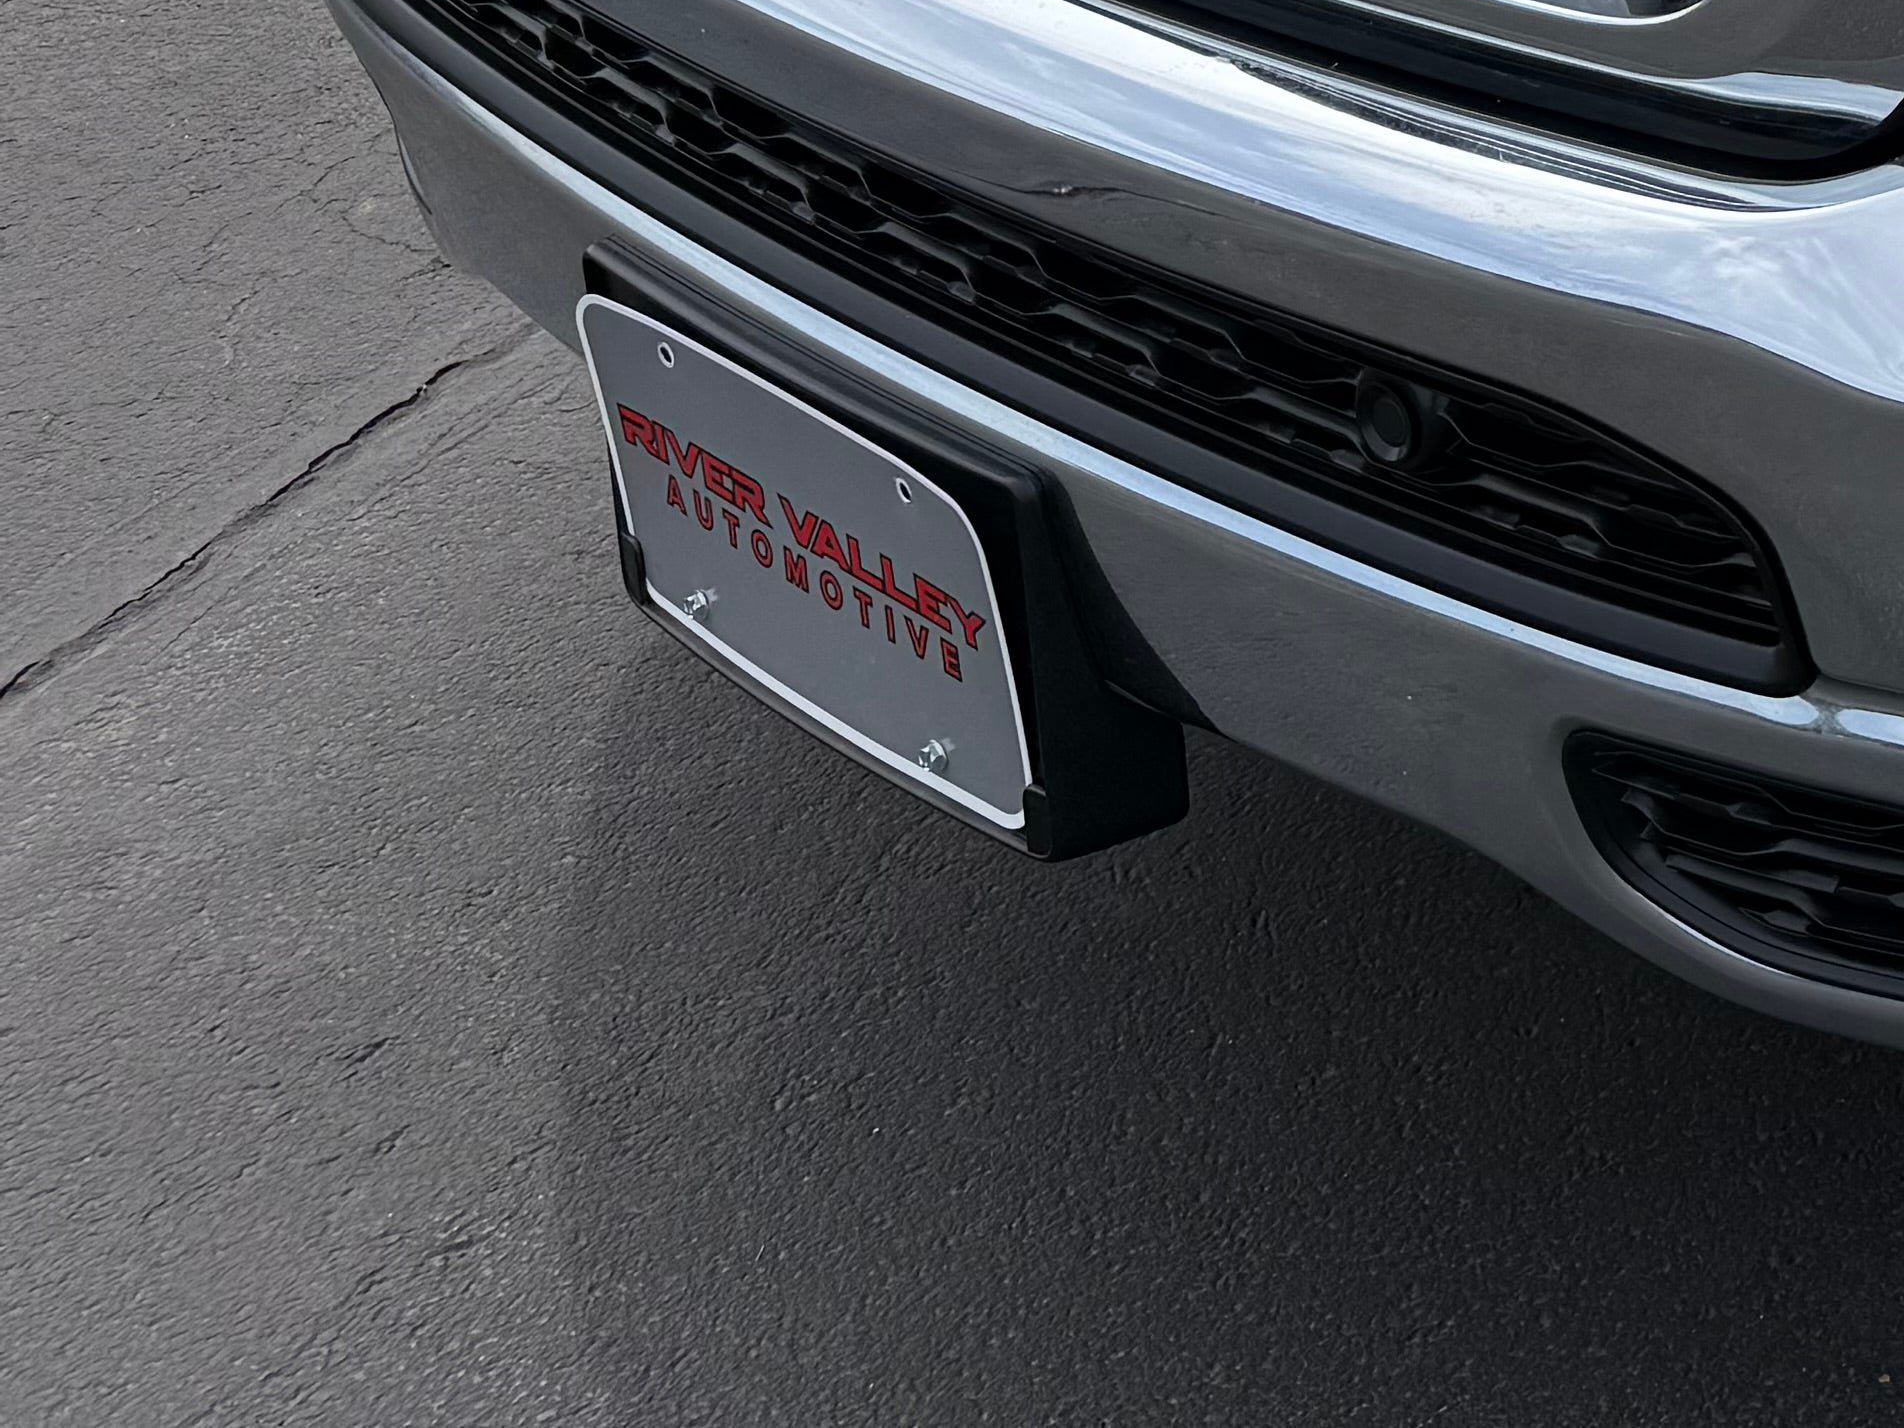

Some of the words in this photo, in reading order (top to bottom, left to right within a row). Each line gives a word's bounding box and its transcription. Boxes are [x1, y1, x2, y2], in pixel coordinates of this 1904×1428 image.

[617, 403, 773, 529] RIVER
[776, 492, 987, 652] VALLEY
[667, 477, 964, 682] AUTOMOTIVE
